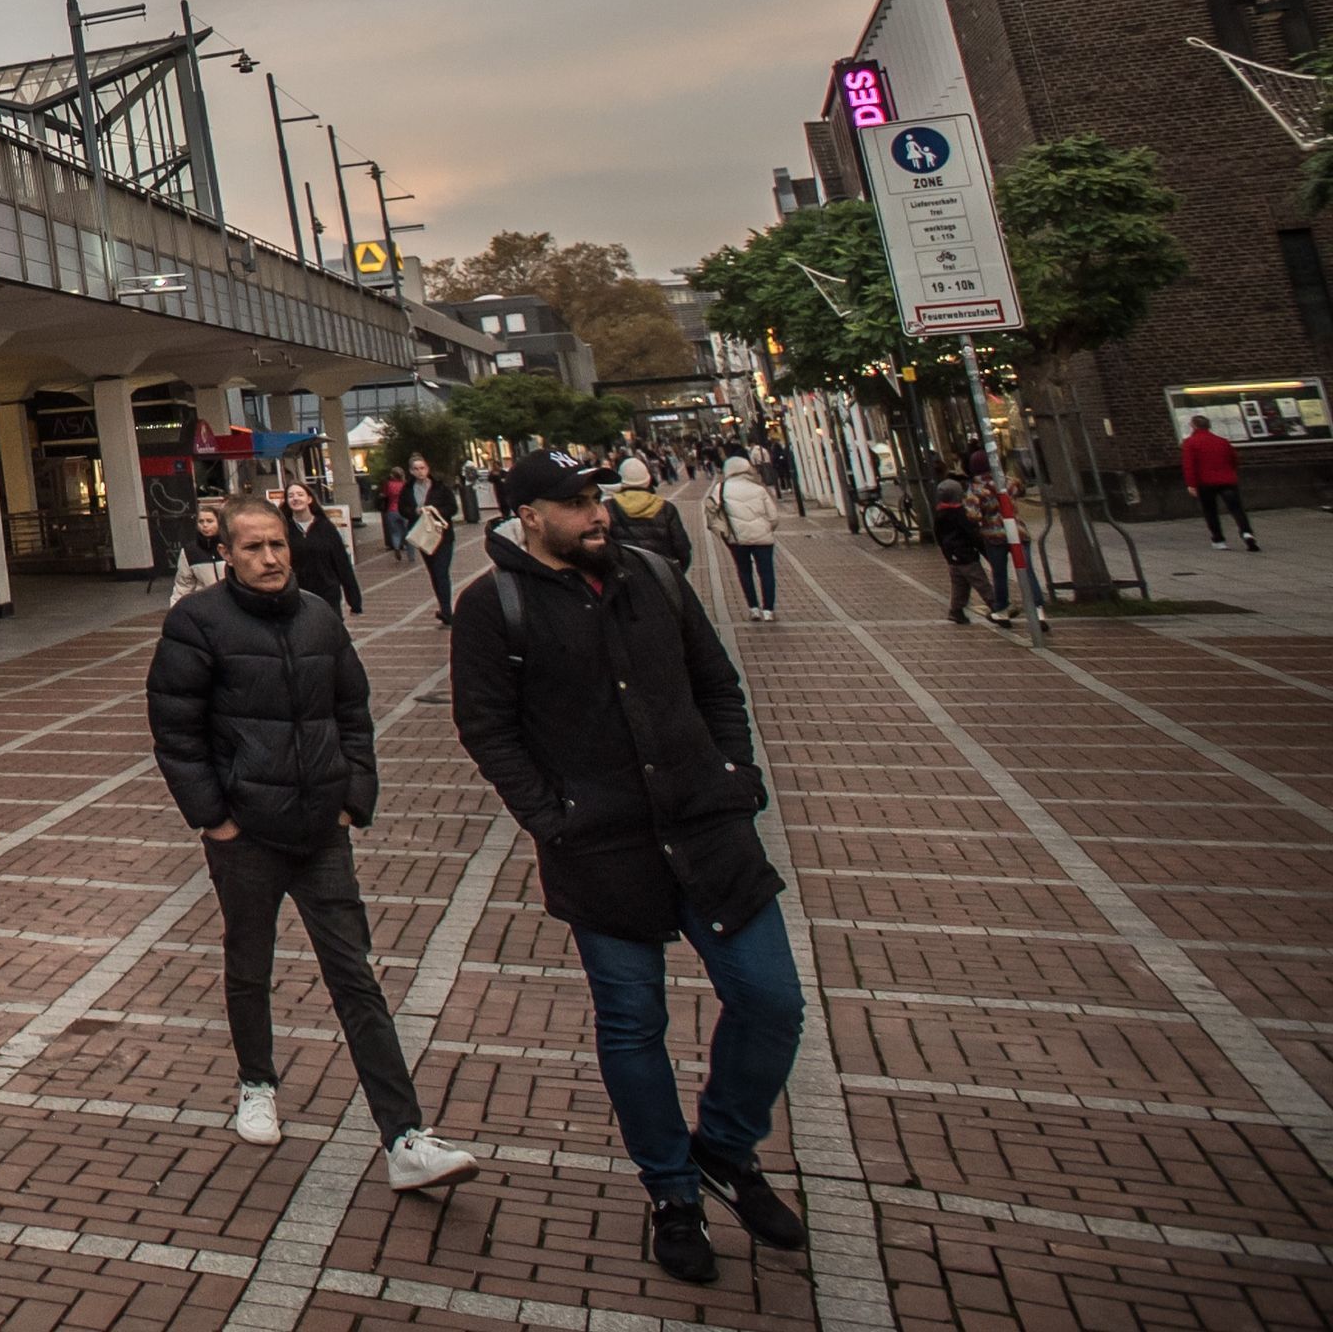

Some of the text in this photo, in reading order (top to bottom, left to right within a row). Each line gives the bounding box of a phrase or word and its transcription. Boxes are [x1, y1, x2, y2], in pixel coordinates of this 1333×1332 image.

[913, 176, 944, 189] ZONE
[910, 197, 958, 209] Lieferverkehr
[930, 208, 943, 216] frei
[923, 224, 957, 233] werktags
[942, 263, 956, 271] frei
[931, 282, 944, 293] 19
[954, 280, 976, 291] 10h
[921, 307, 999, 321] Feuerwehrzufahrt
[549, 451, 579, 468] NY
